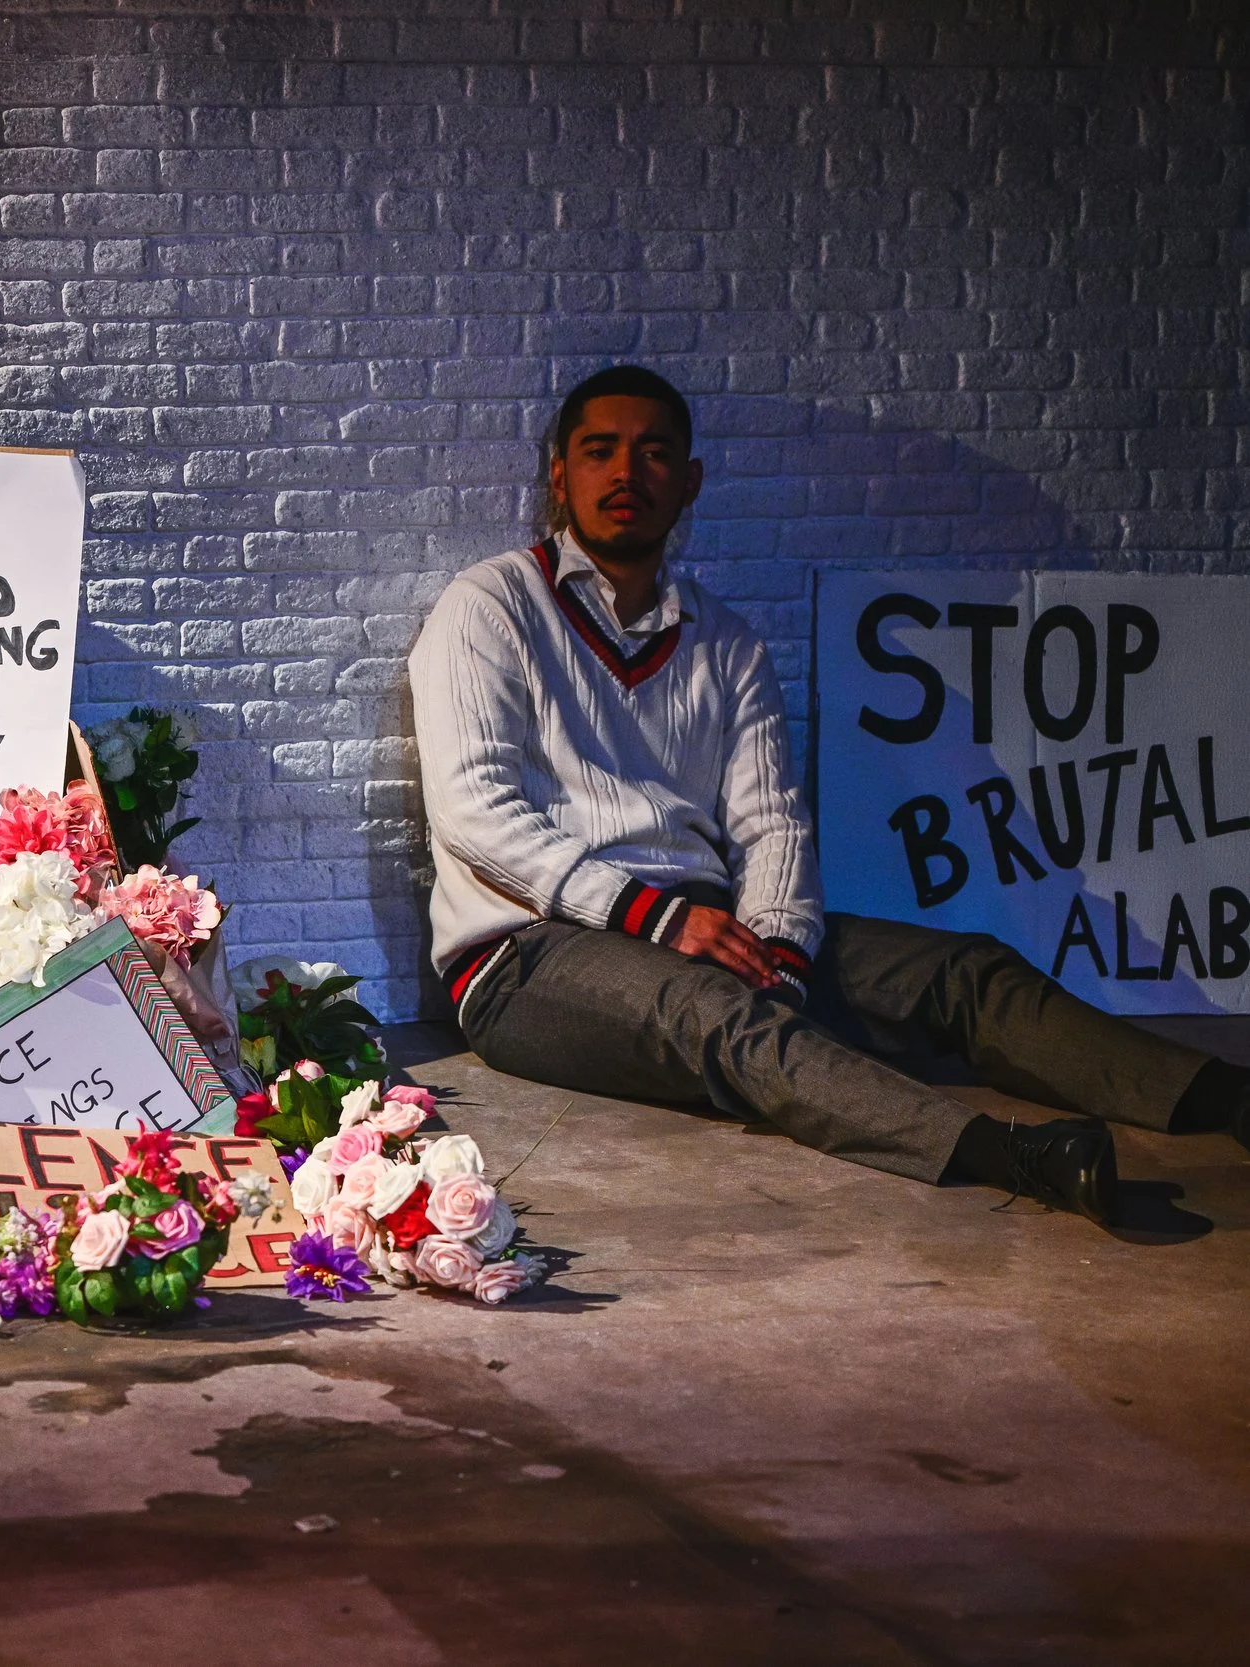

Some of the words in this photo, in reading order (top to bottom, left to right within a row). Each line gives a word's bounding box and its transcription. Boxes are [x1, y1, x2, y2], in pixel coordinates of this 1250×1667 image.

[856, 593, 1160, 744] STOP
[887, 736, 1250, 909] BRUTAL
[1051, 886, 1250, 981] ALAB
